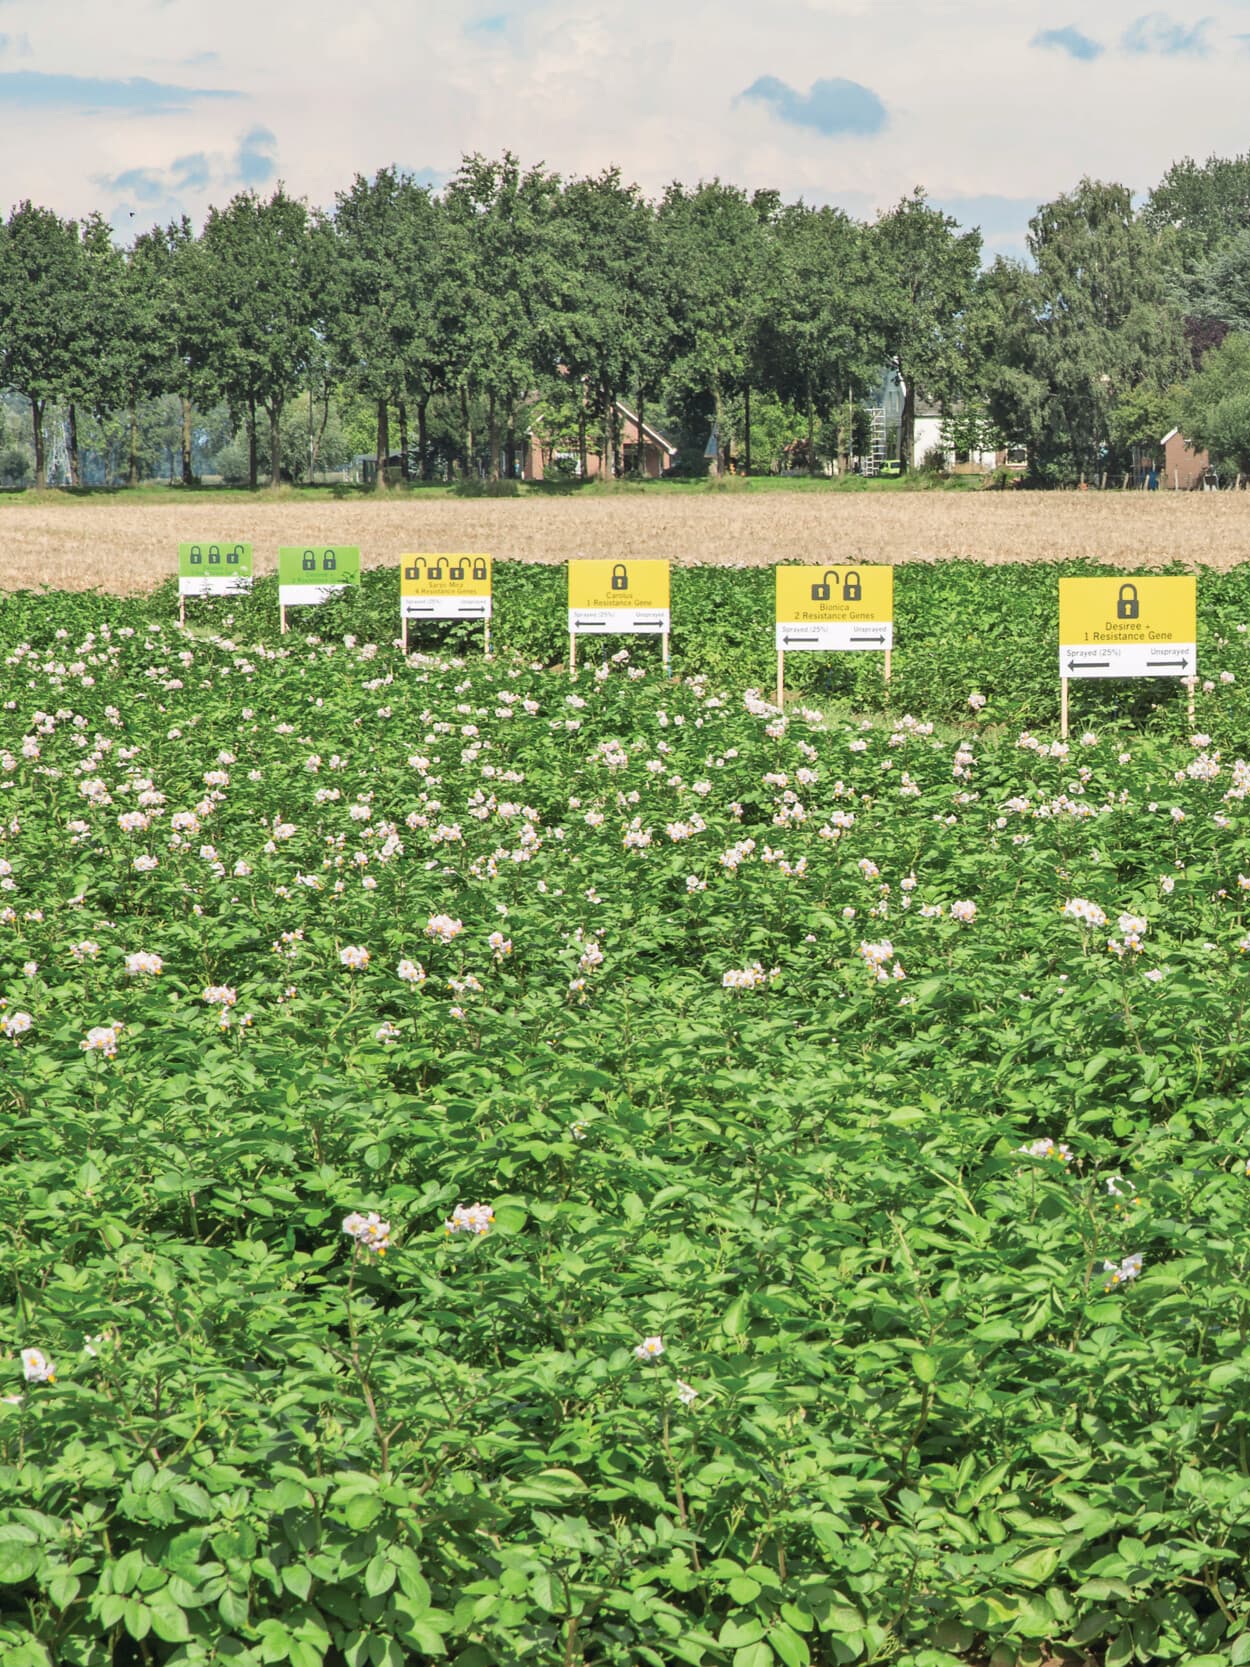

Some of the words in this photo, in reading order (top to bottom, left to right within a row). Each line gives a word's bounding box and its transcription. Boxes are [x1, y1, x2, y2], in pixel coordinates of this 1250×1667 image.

[794, 612, 800, 620] 2
[802, 611, 847, 620] Resistance
[849, 611, 875, 620] Genes
[782, 626, 809, 634] Sprayed
[1105, 622, 1142, 631] Desiree
[1084, 632, 1088, 641] 1
[1093, 631, 1145, 641] Resistance
[1148, 631, 1173, 640] Gene
[1066, 649, 1097, 657] Sprayed
[1099, 648, 1121, 657] (25%)
[1150, 648, 1189, 656] Unsprayed
